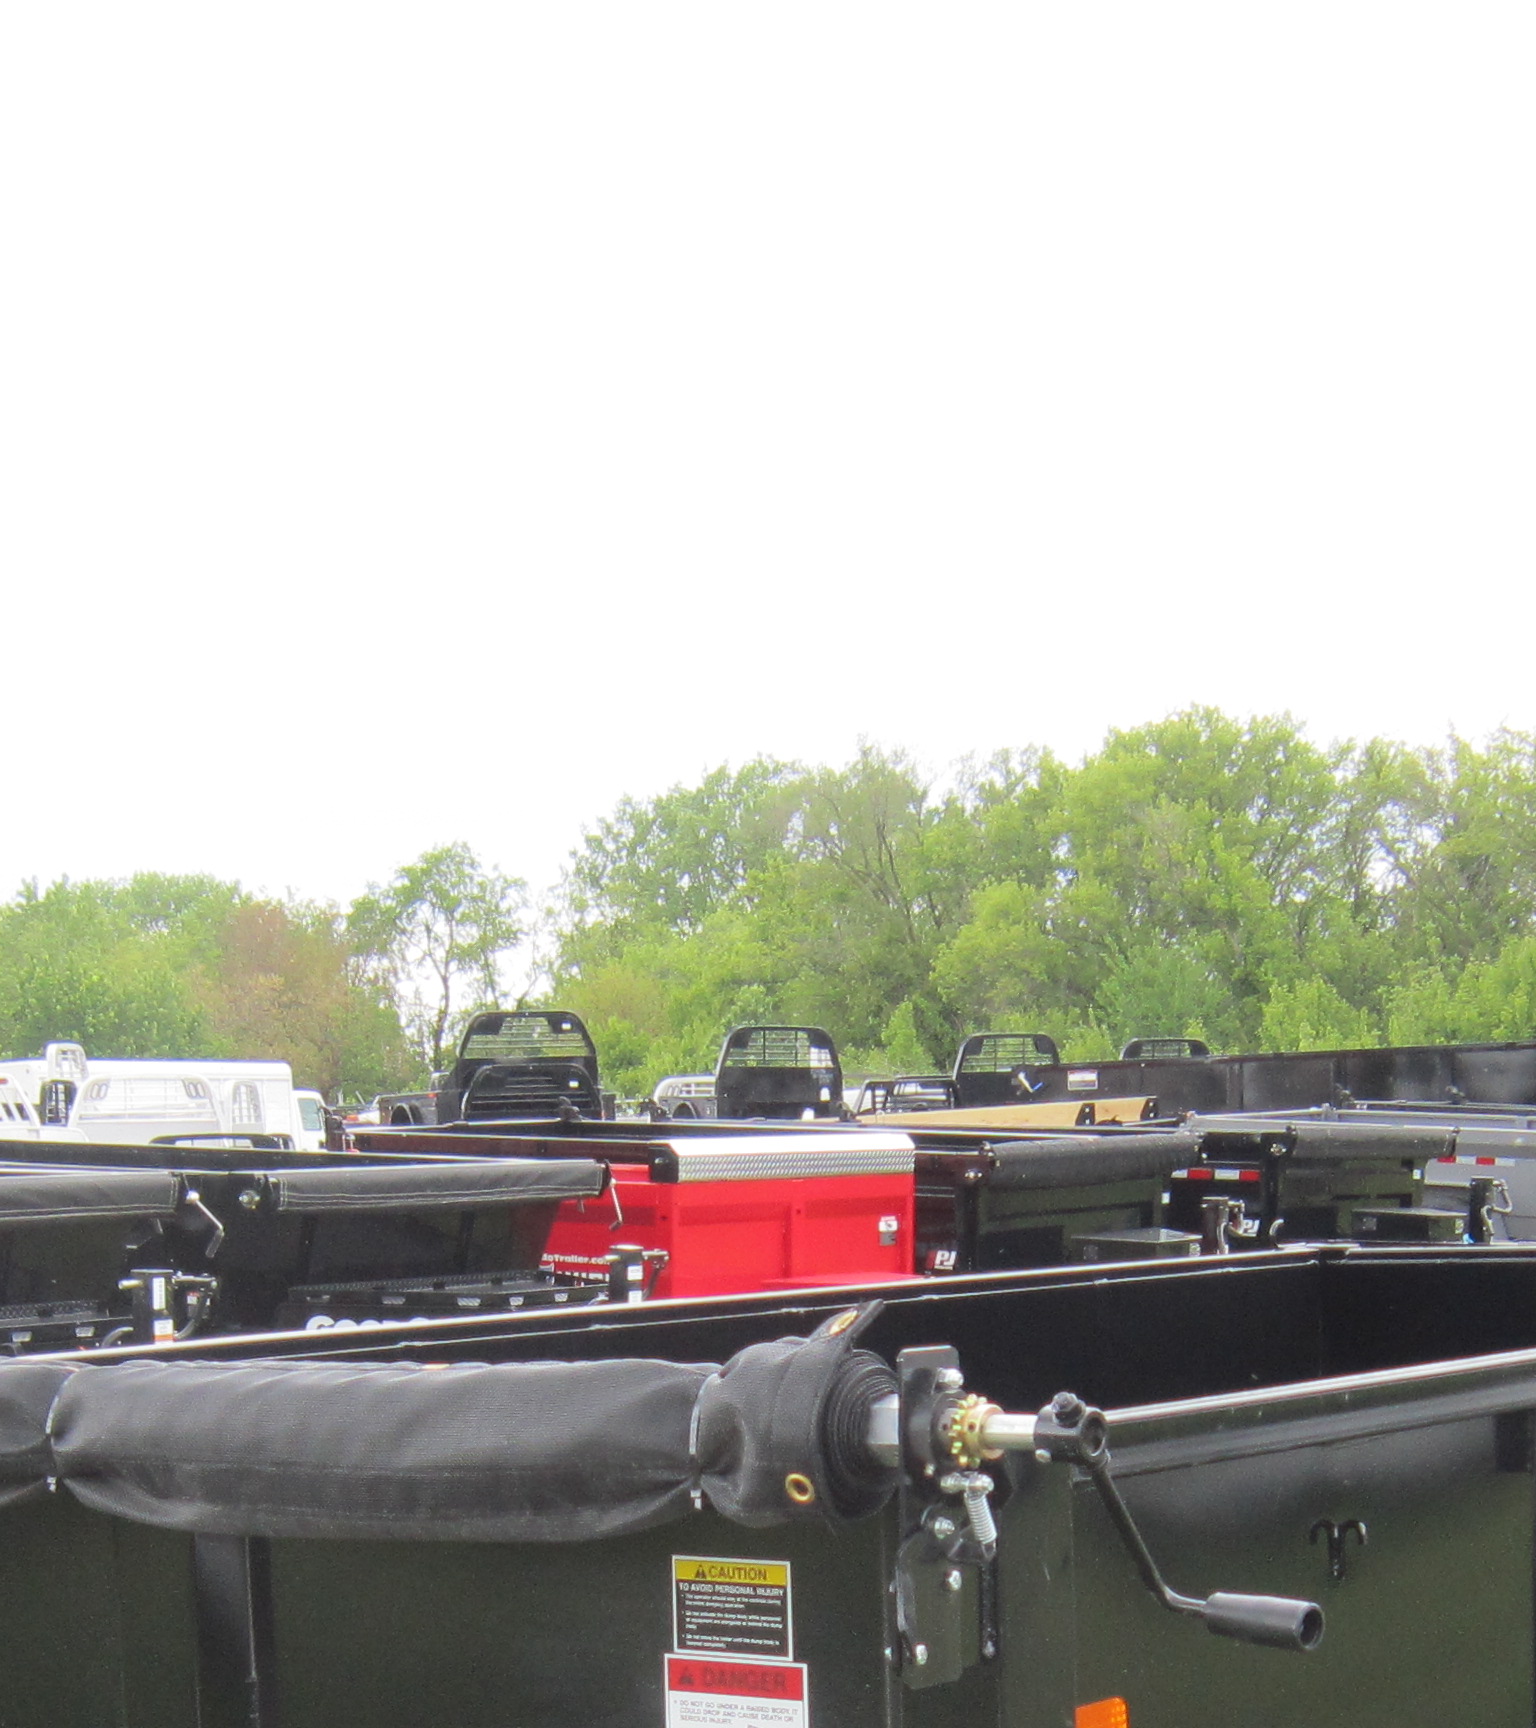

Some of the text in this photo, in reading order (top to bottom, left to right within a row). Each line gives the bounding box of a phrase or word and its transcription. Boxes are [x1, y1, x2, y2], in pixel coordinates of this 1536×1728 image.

[708, 1565, 767, 1581] CAUTION
[679, 1583, 784, 1597] TO AVOID PERSONAL INJURY
[703, 1667, 787, 1692] DANGER
[690, 1700, 703, 1708] NOT
[705, 1701, 714, 1709] GO
[722, 1710, 736, 1718] AND
[760, 1713, 781, 1722] DEATH
